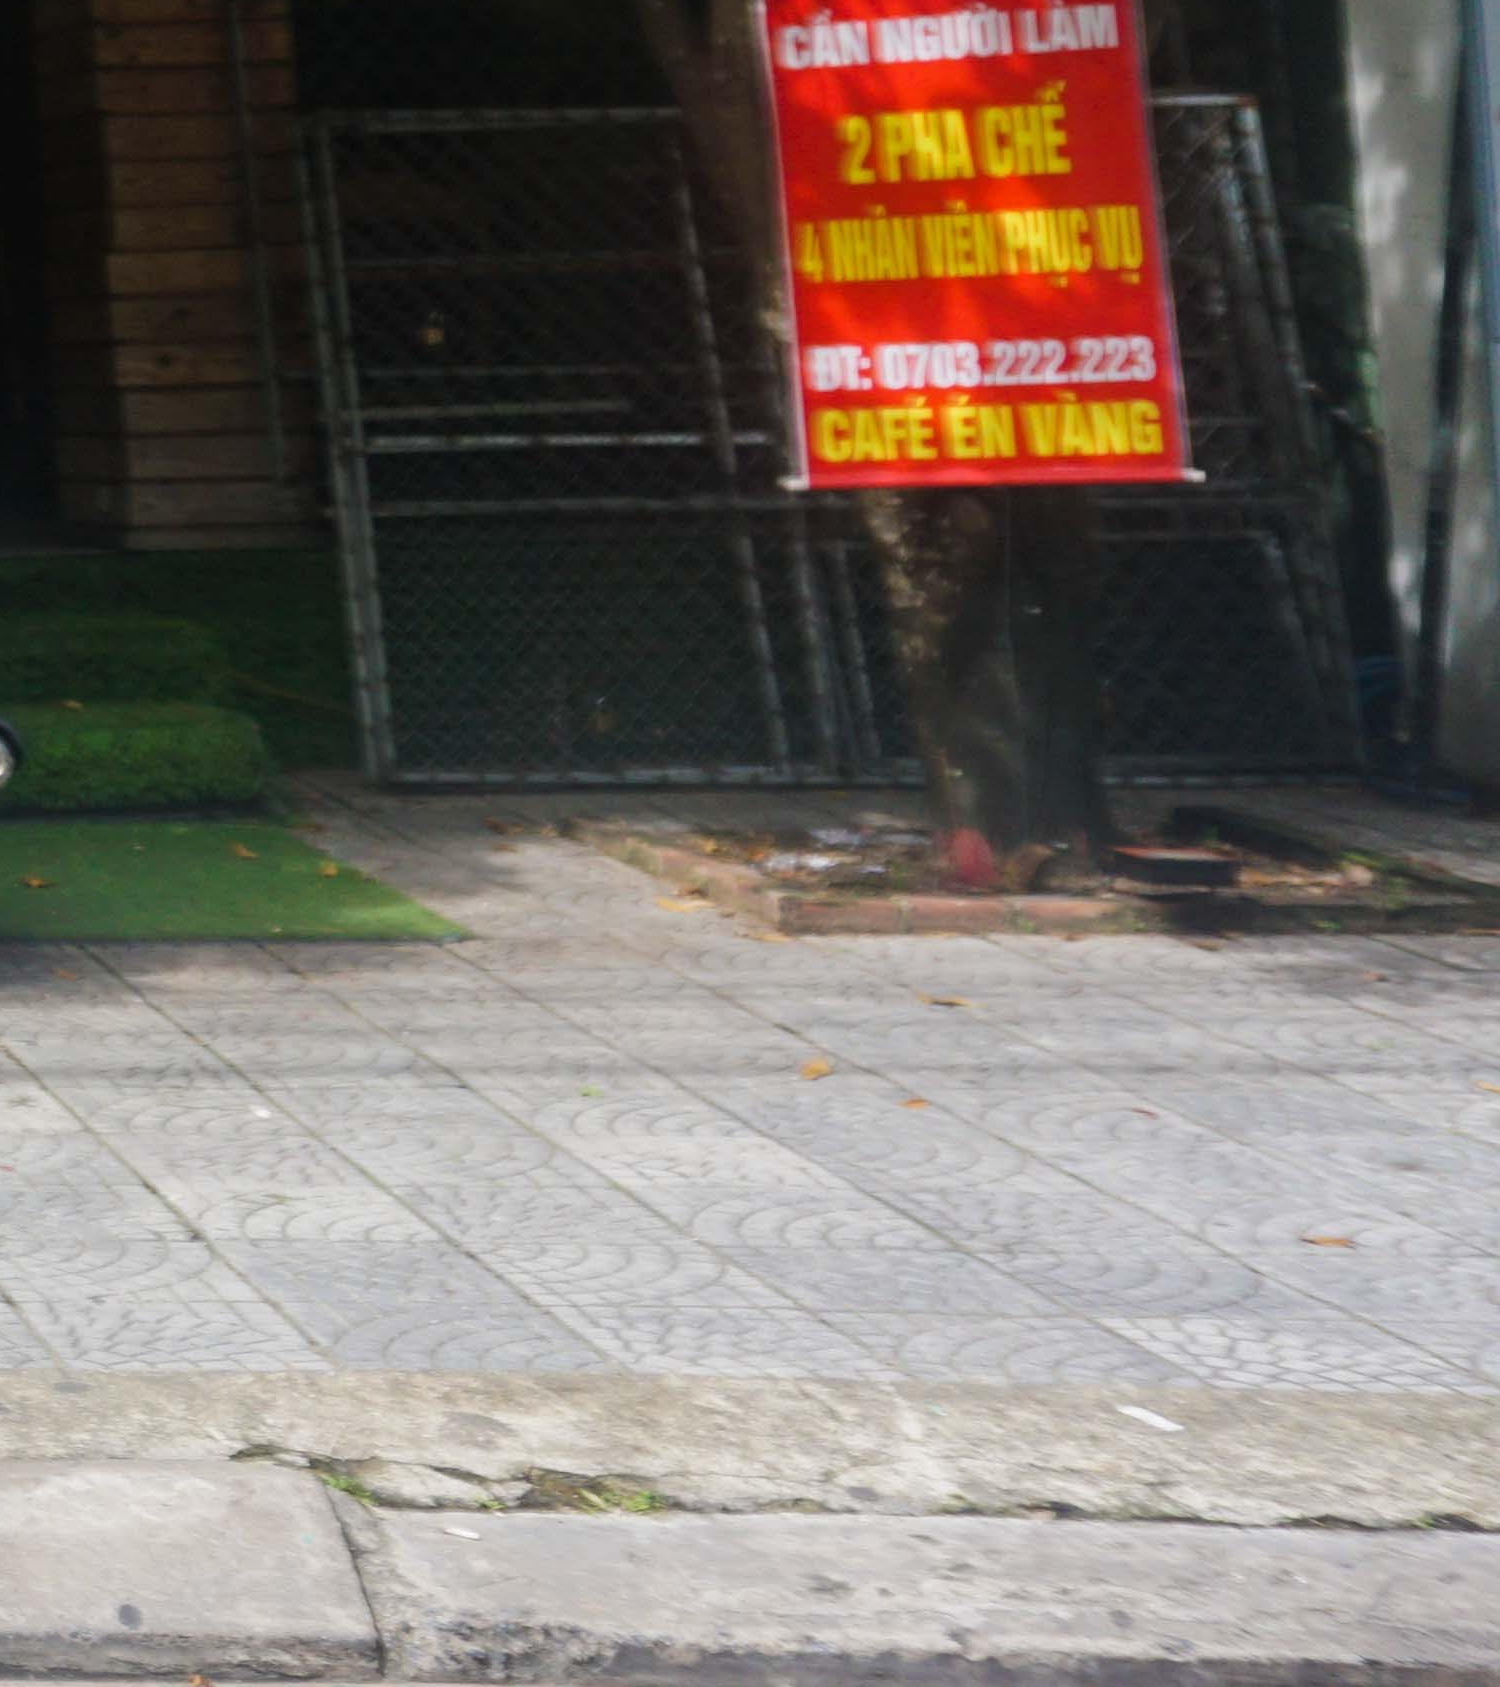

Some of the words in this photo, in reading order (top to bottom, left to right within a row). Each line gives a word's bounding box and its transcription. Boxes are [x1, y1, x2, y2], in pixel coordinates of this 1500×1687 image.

[875, 3, 1013, 63] NGƯỜI
[1018, 0, 1119, 52] LÀM
[839, 115, 876, 184] 2
[878, 109, 975, 183] PHA
[980, 81, 1071, 177] CHẾ
[799, 222, 823, 283] 4
[827, 205, 919, 281] NHÂN
[922, 200, 999, 278] VIÊN
[1000, 208, 1092, 288] PHỤC
[1096, 205, 1143, 285] VỤ
[806, 344, 873, 391] ĐT:
[876, 335, 1157, 389] 0703.222.223
[818, 393, 937, 462] CAFÉ
[944, 393, 1017, 458] ÉN
[1022, 391, 1162, 457] VÀNG
